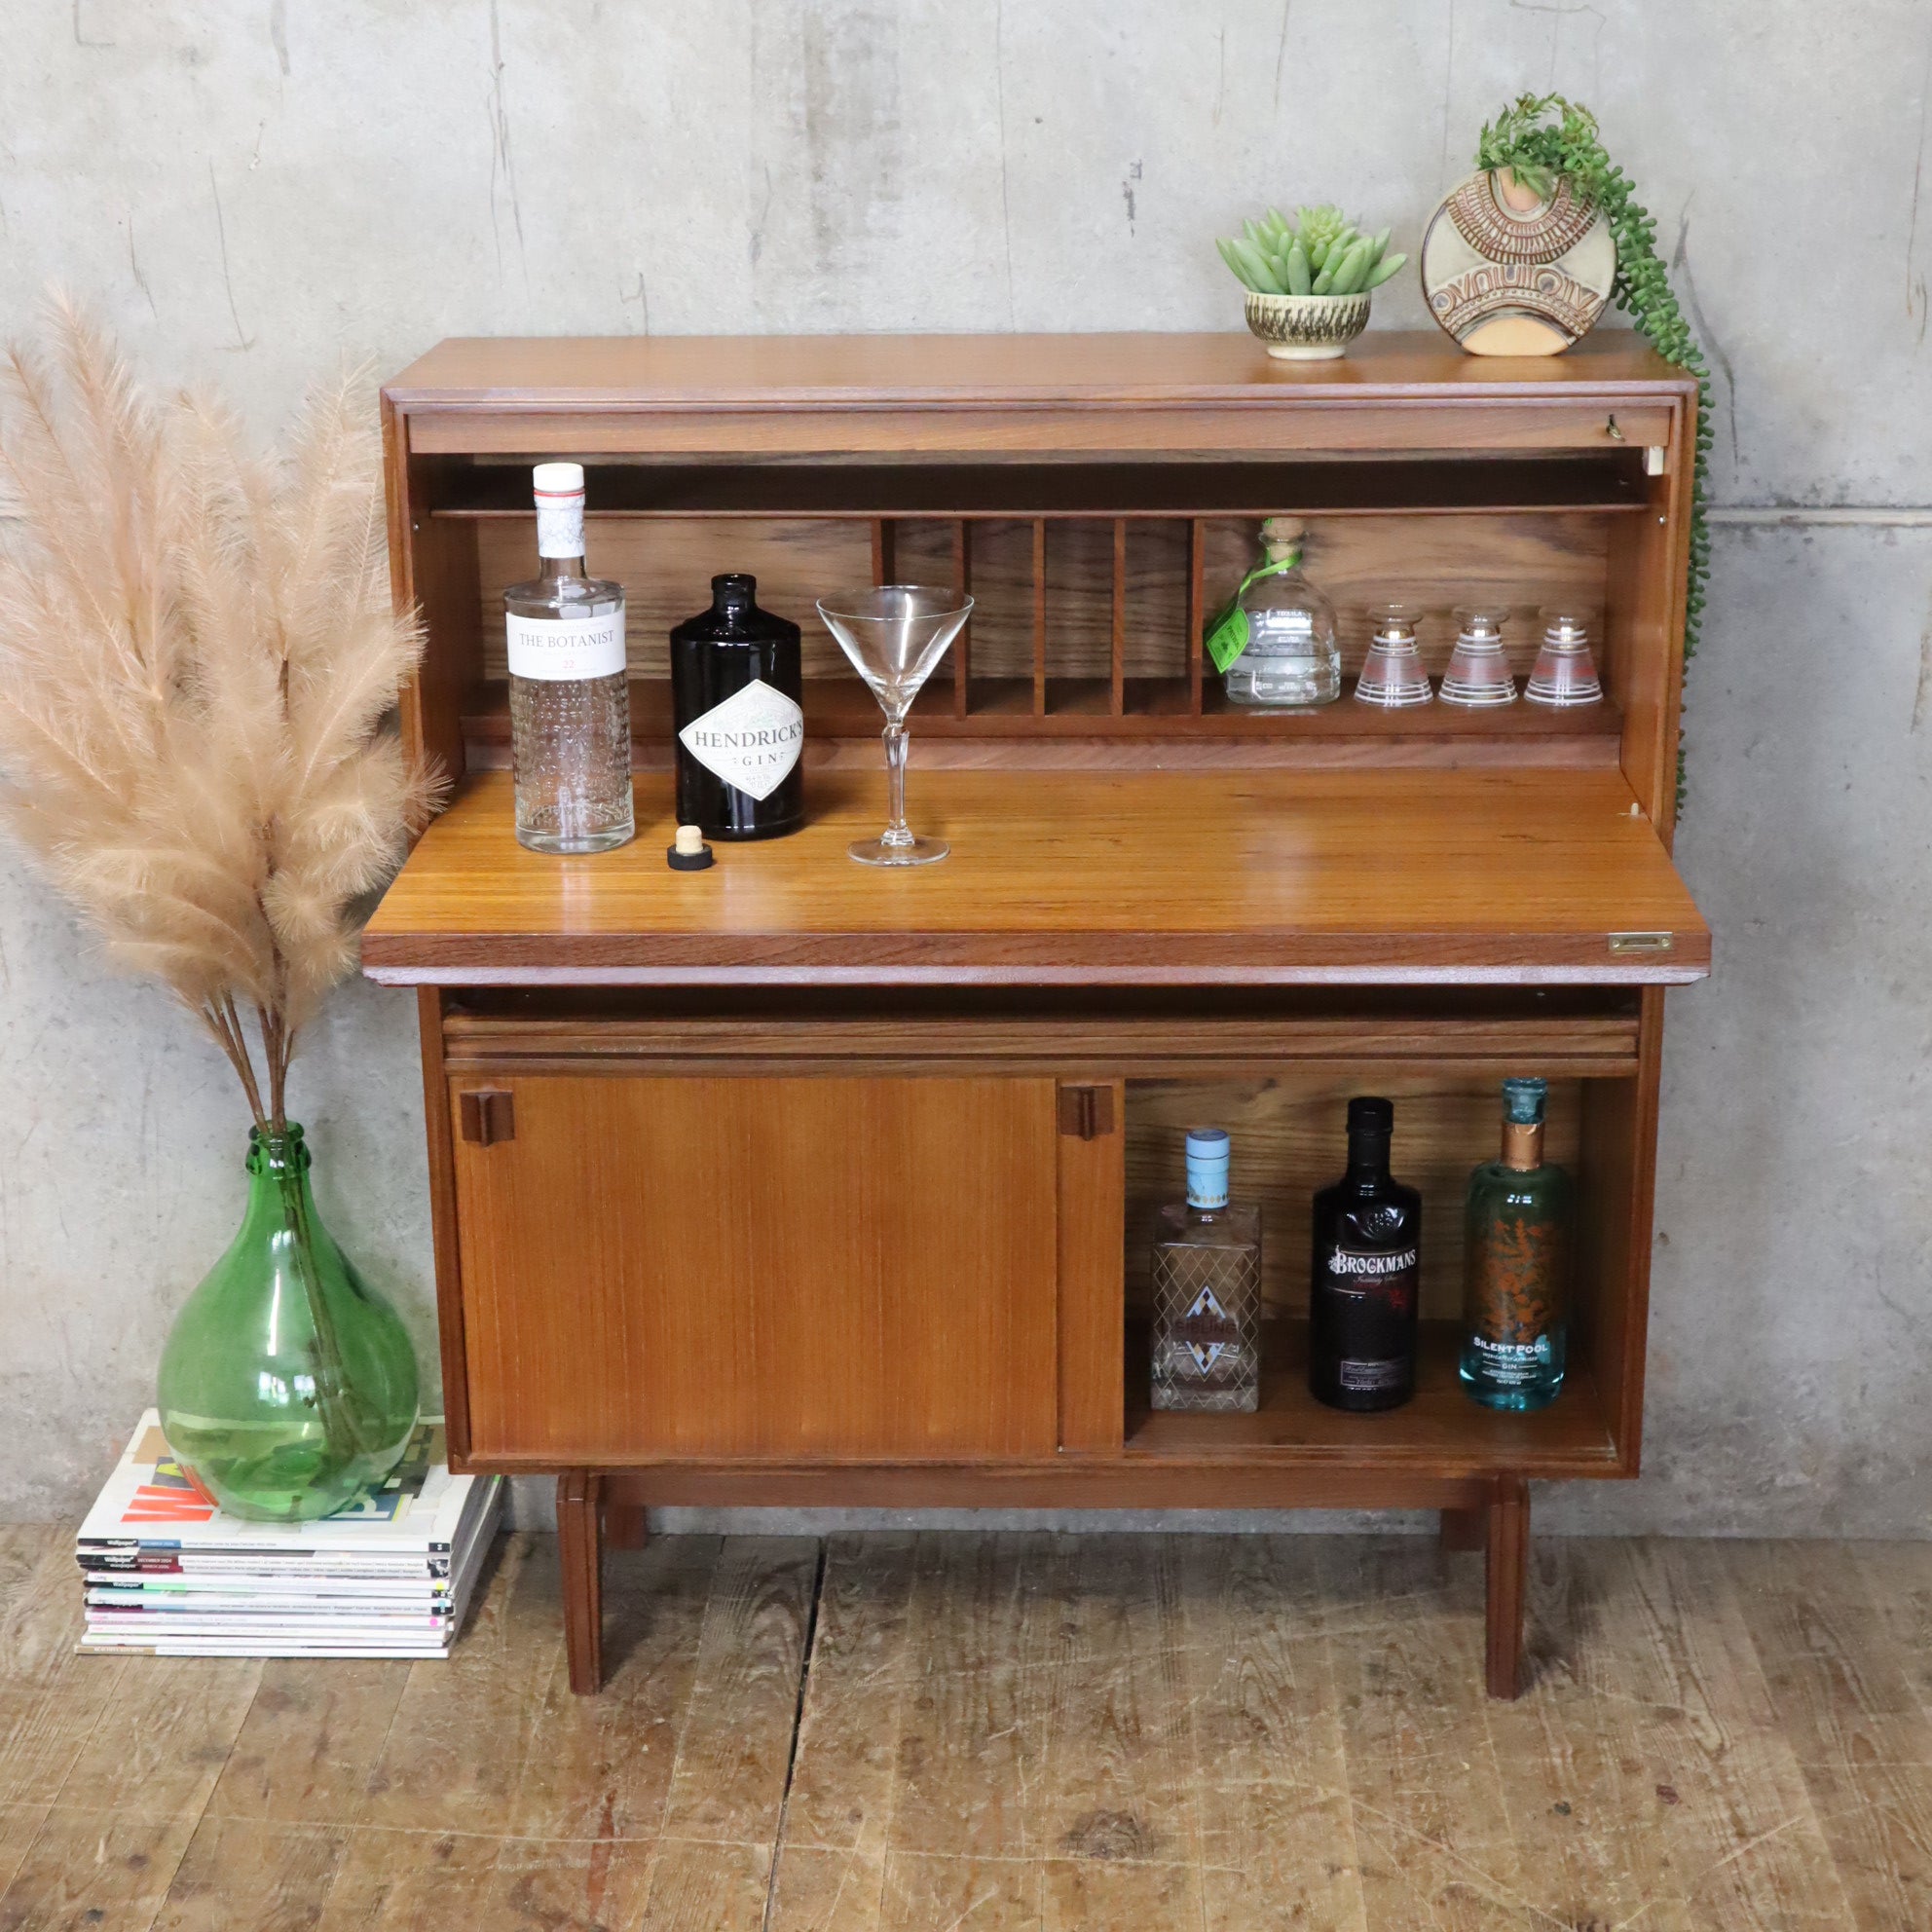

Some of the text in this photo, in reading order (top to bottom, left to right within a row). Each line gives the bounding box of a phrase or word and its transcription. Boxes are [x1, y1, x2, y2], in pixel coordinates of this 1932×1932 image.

[519, 629, 614, 648] THE BOTANIST
[742, 753, 777, 766] GIN
[1328, 1245, 1416, 1275] BROCKMANS
[1473, 1336, 1548, 1355] SILENT POOL
